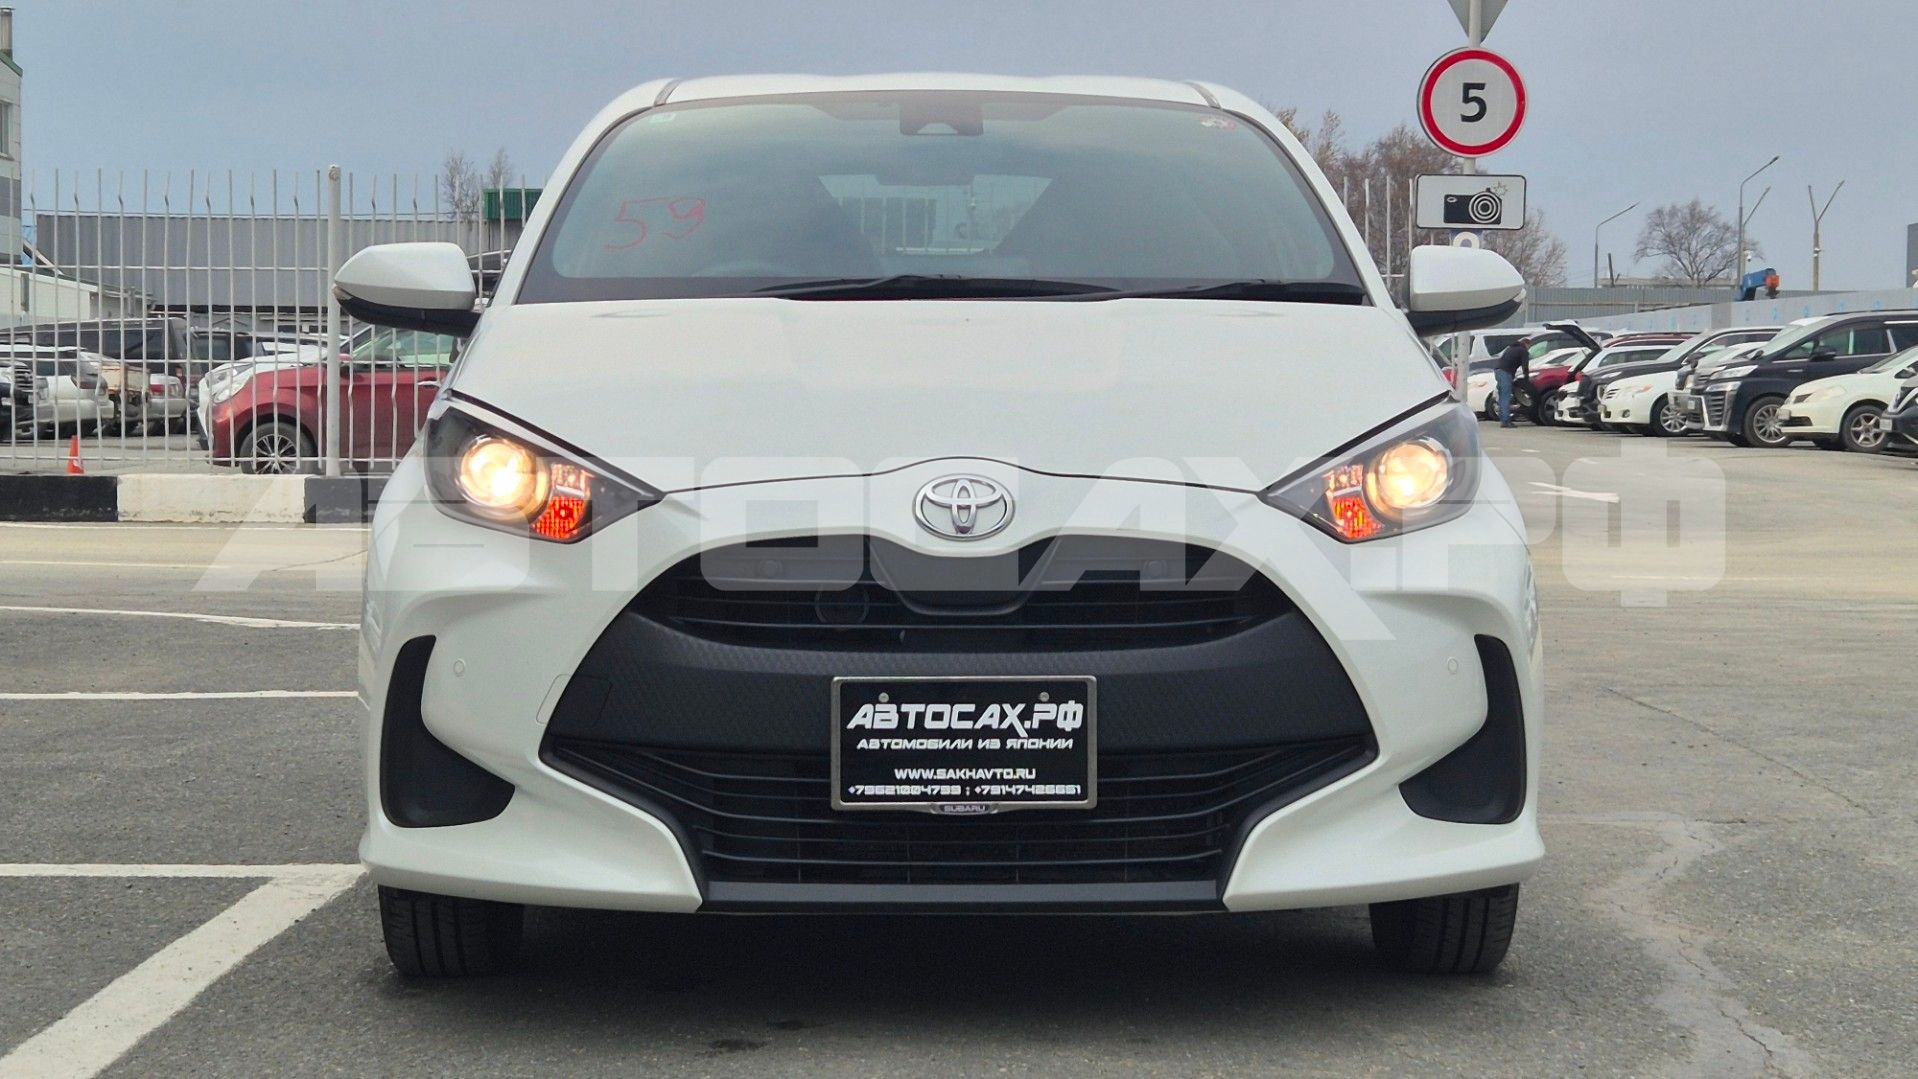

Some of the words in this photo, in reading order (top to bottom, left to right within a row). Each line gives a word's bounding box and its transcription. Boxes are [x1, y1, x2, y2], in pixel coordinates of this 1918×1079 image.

[1460, 82, 1487, 123] 5
[603, 196, 705, 252] 59
[847, 700, 1084, 738] АВТОСАХ.РФ
[856, 738, 973, 750] АВТОМОБИЛИ
[977, 738, 1001, 750] ИЗ
[1005, 738, 1074, 750] ЯПОНИИ
[894, 768, 1036, 781] WWW.SAKHAVTO.RU
[943, 804, 986, 812] SUBARU
